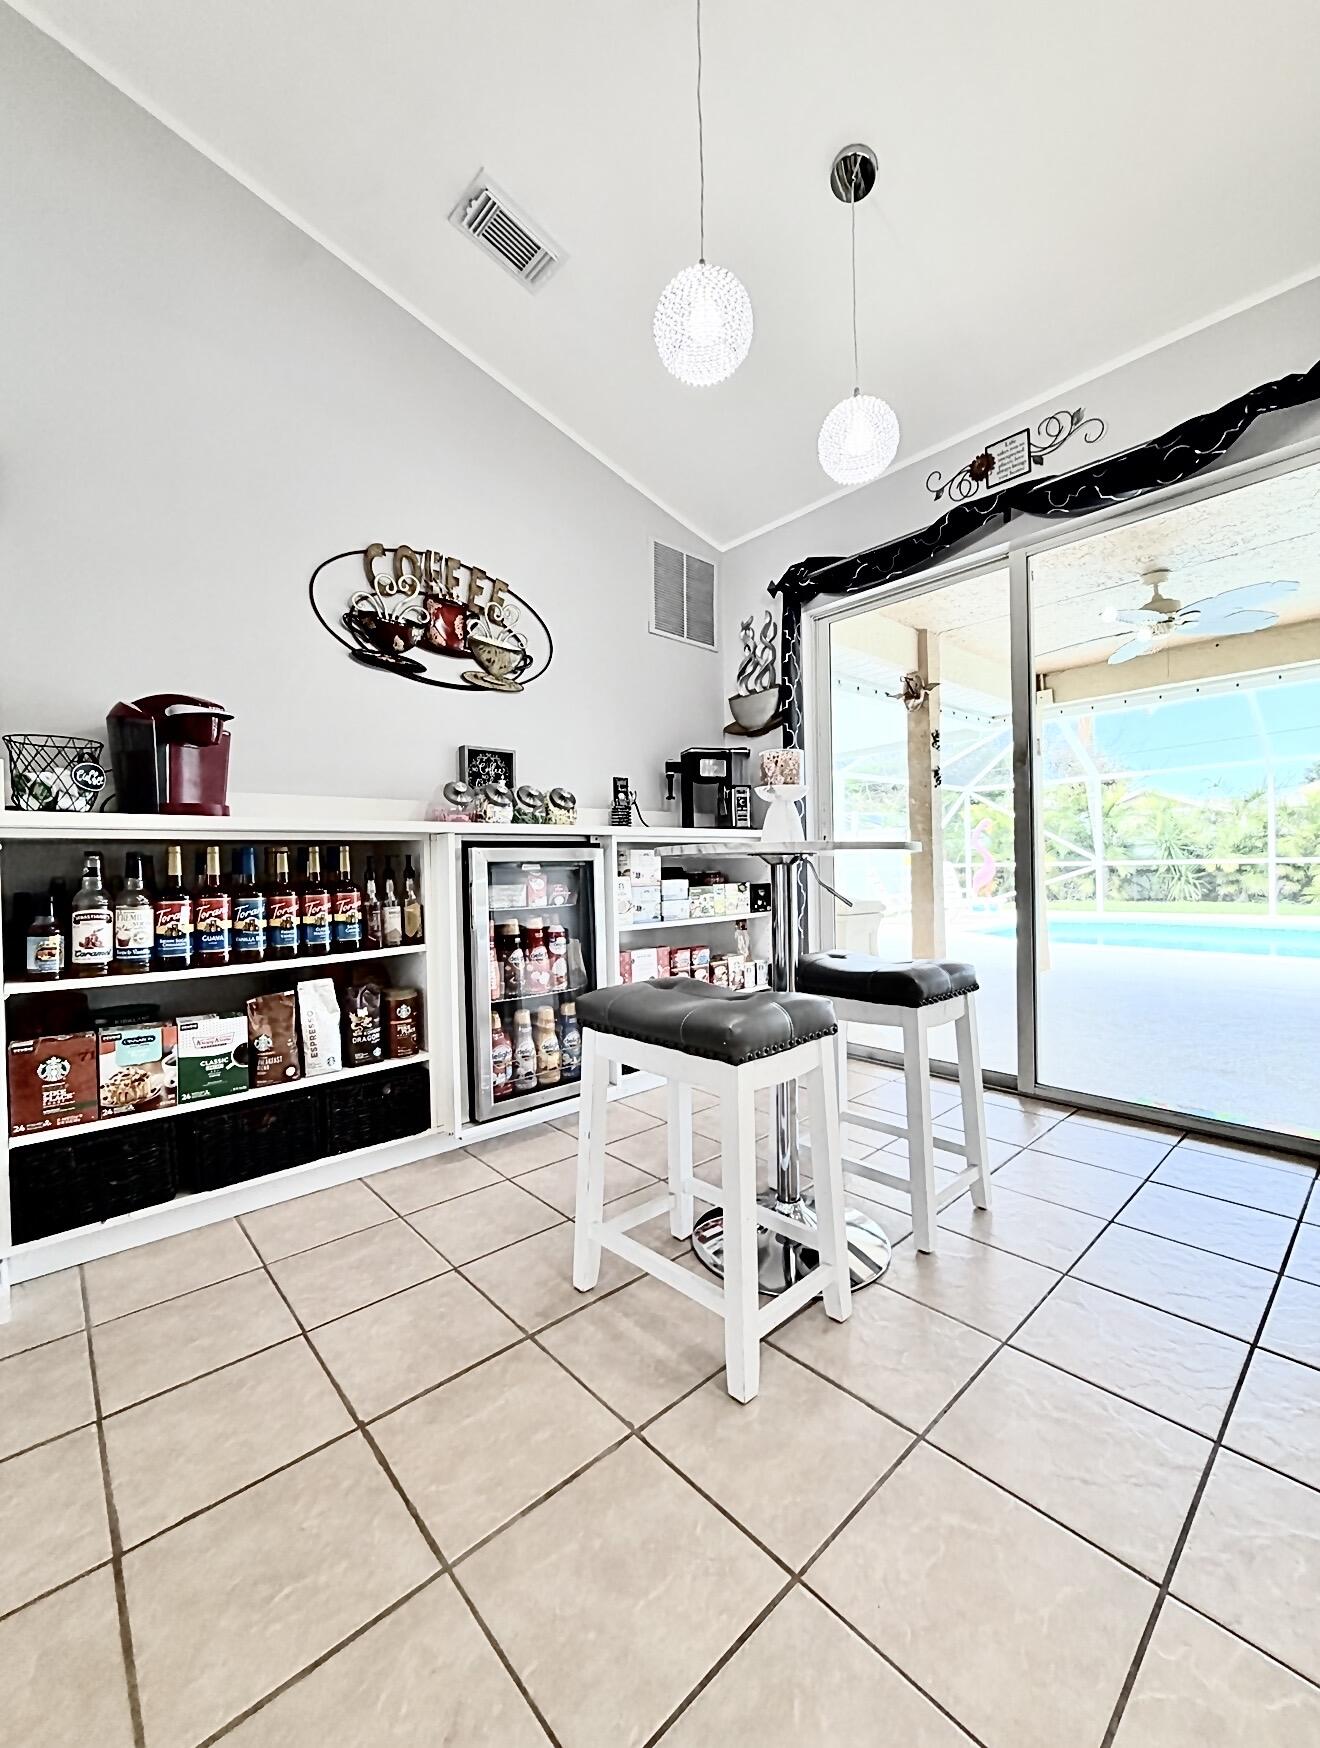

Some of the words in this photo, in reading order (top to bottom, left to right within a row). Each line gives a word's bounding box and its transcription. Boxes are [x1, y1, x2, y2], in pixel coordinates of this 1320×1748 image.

[363, 543, 510, 626] COFFEE
[306, 1010, 319, 1059] ESPRESSO
[352, 1033, 380, 1044] DRAGON
[200, 1057, 229, 1067] CLASSIC
